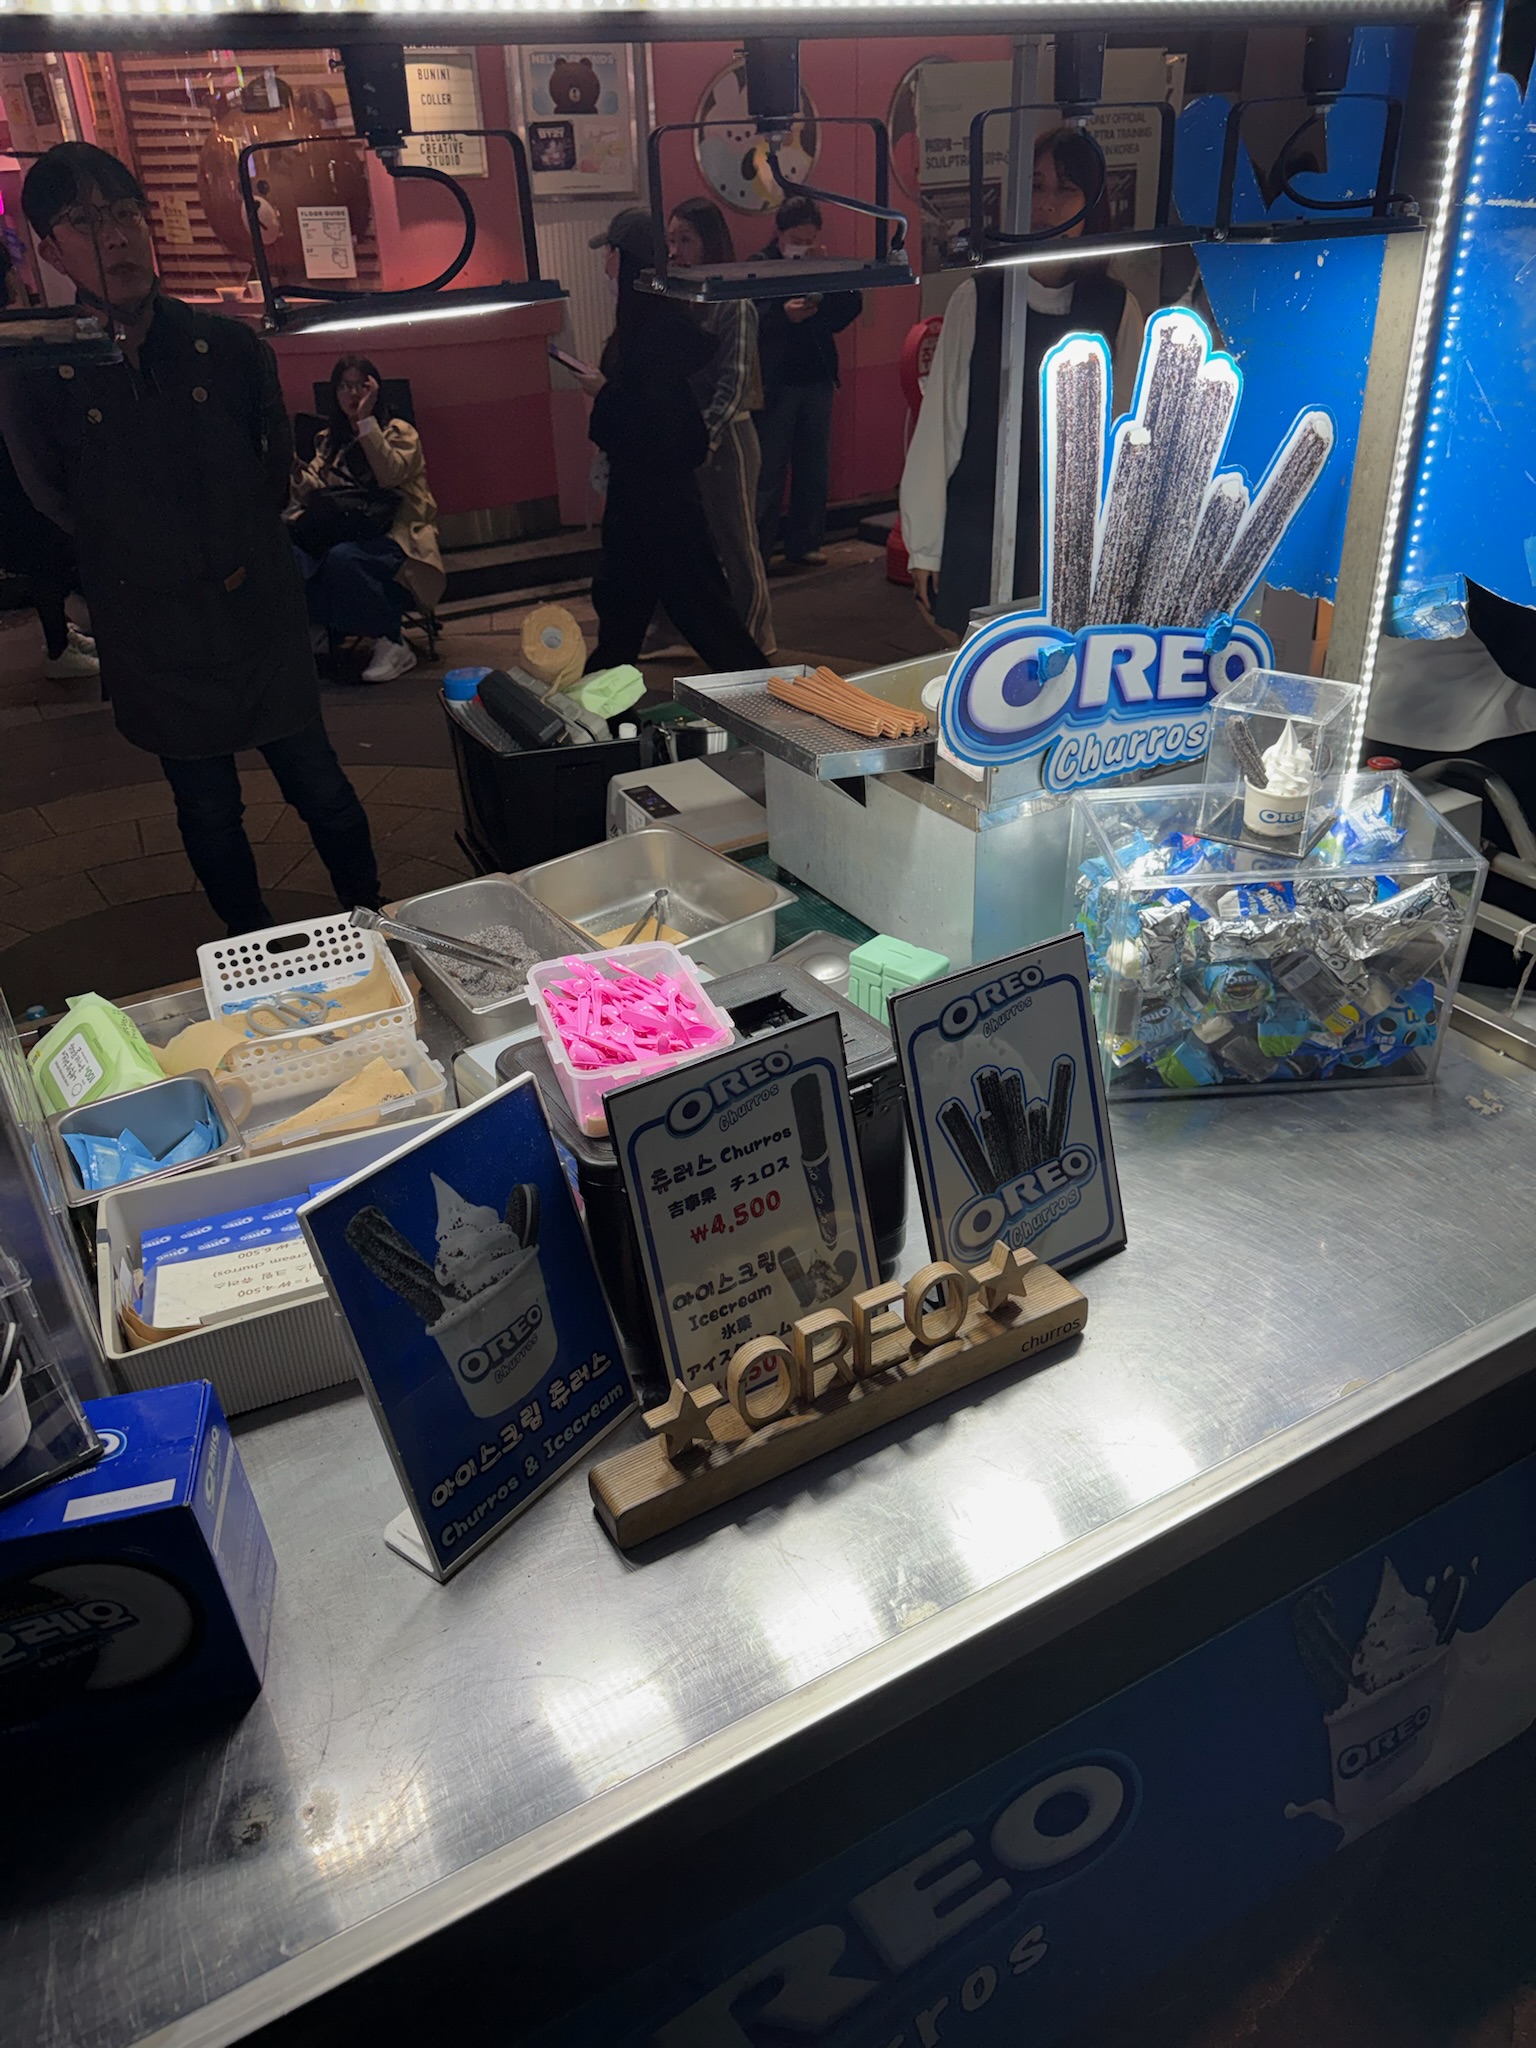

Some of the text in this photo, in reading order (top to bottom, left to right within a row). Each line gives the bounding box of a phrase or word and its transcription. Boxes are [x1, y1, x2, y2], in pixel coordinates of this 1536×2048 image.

[417, 69, 451, 80] BUNINI
[421, 94, 452, 105] COLLER
[420, 143, 464, 155] CREATIVE
[427, 155, 460, 166] STUDIO
[967, 633, 1260, 734] OREO
[1055, 722, 1208, 783] Churros
[1259, 809, 1306, 824] ORE
[940, 965, 1046, 1041] OREO
[982, 996, 1033, 1039] Churros
[665, 1050, 793, 1139] OREO
[718, 1082, 780, 1133] Churros
[651, 1127, 792, 1195] 츄러스 Churros
[729, 1155, 791, 1192] チュロス
[955, 1149, 1092, 1251] OREO
[1010, 1189, 1079, 1249] Churros
[213, 1252, 308, 1278] cream churros)
[214, 1276, 254, 1290] 츄러스
[672, 1249, 778, 1312] 아이스크림
[688, 1284, 772, 1332] Icecream
[1020, 1316, 1082, 1354] churros
[458, 1303, 544, 1385] OREO
[494, 1333, 539, 1384] Churros
[727, 1261, 969, 1430] OREO
[431, 1352, 612, 1508] 아이스크림 츄러스
[441, 1384, 624, 1547] Churros & Icecream
[1337, 1704, 1431, 1780] OREO
[648, 1764, 1125, 2048] REO
